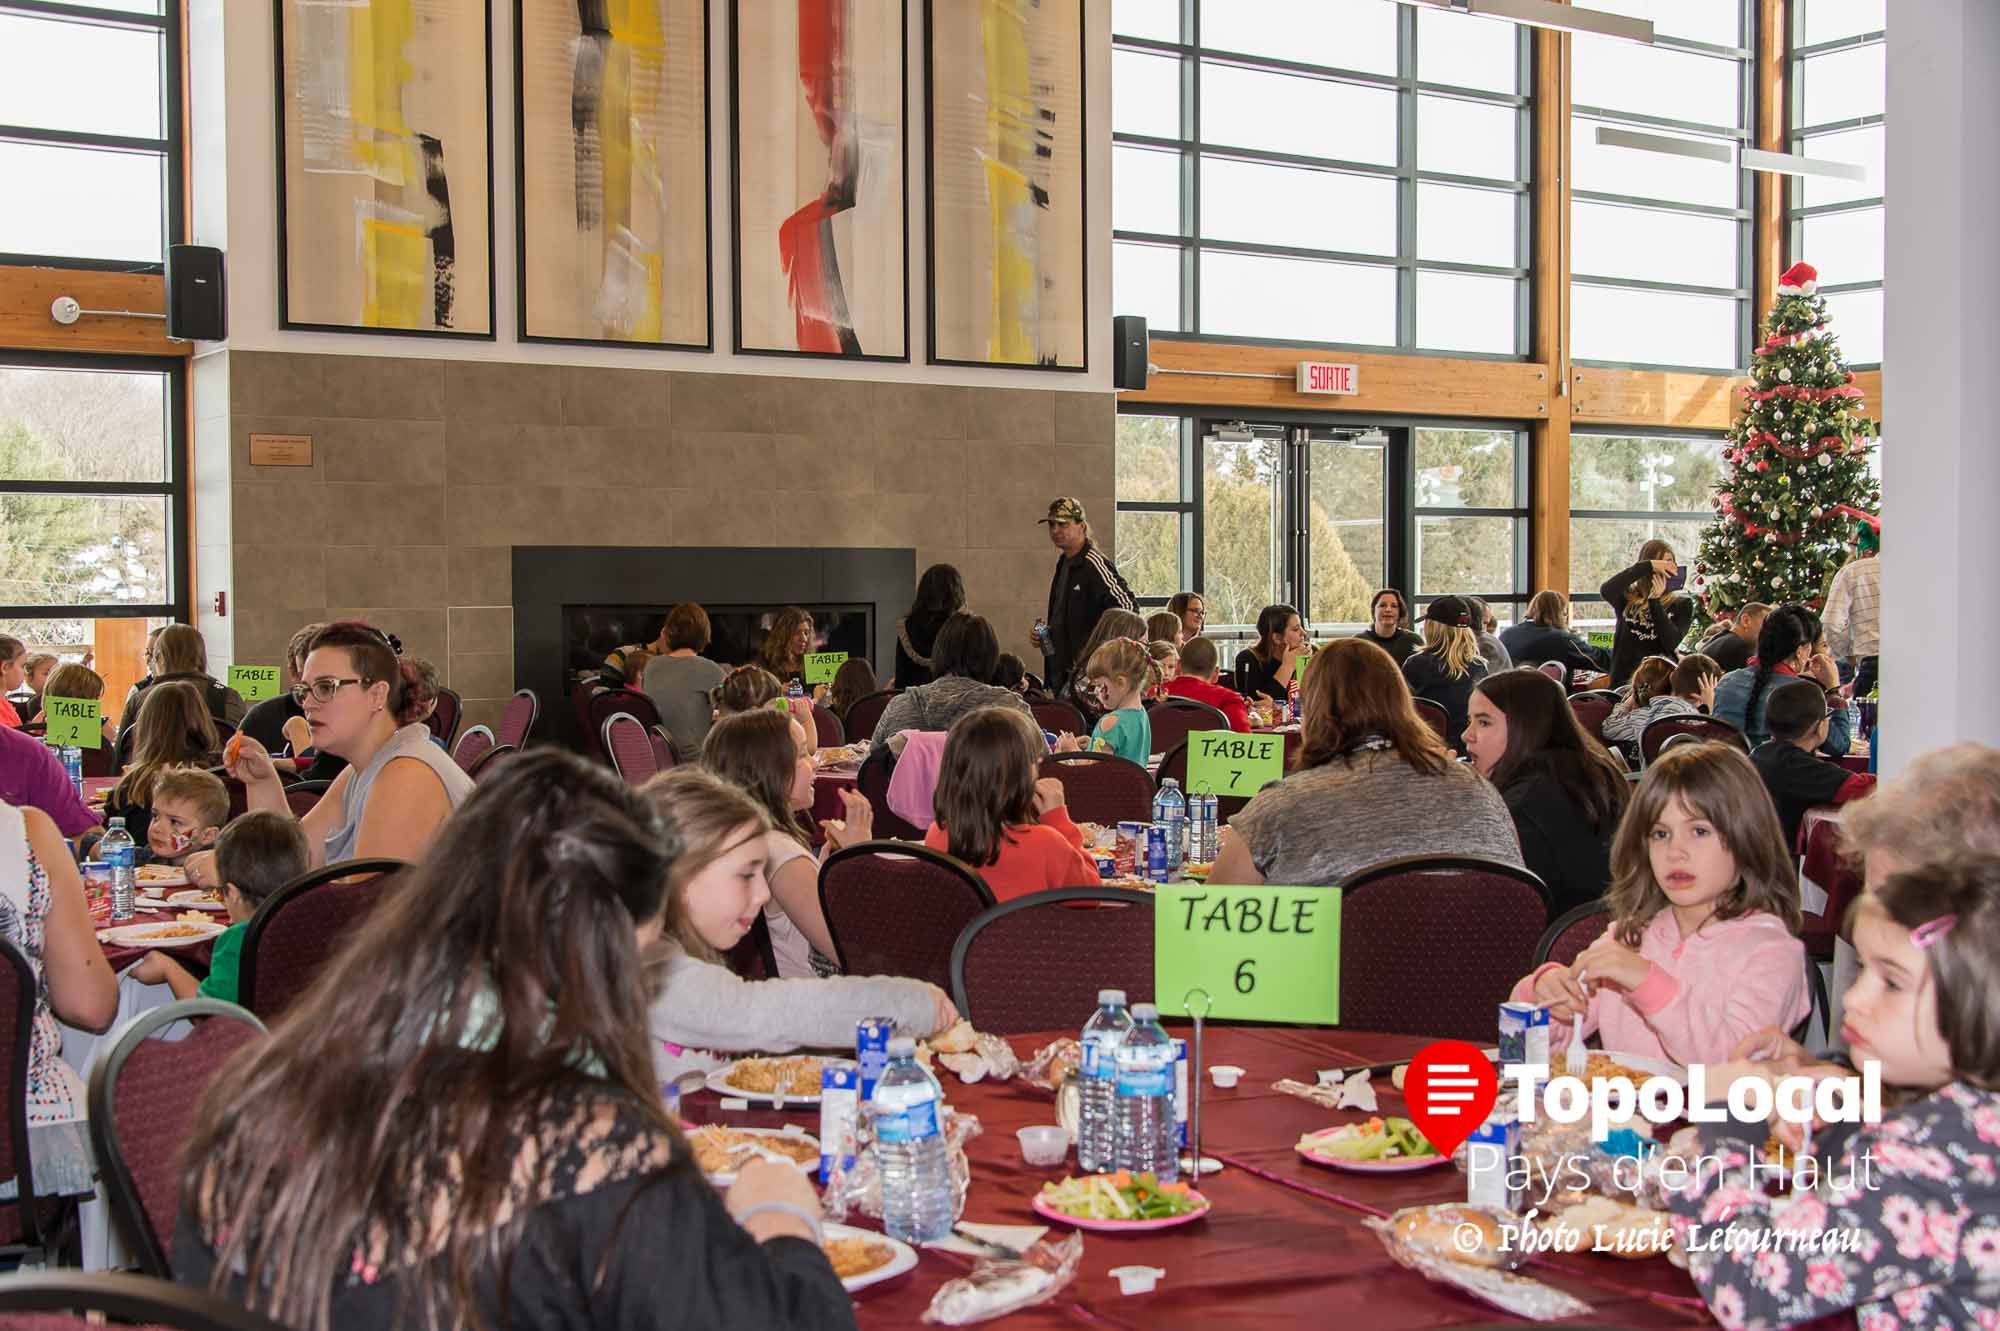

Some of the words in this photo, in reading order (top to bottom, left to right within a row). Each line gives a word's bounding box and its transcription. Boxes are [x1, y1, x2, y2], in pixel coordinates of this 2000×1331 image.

[1310, 365, 1351, 392] SORTIE
[810, 654, 844, 664] TABLE
[235, 669, 277, 681] TABLE
[824, 668, 832, 678] 4
[250, 686, 258, 697] 3
[53, 701, 97, 719] TABLE
[70, 726, 79, 739] 2
[1201, 738, 1275, 760] TABLE
[1229, 769, 1242, 789] 7
[1179, 893, 1320, 934] TABLE
[1234, 958, 1257, 994] 6
